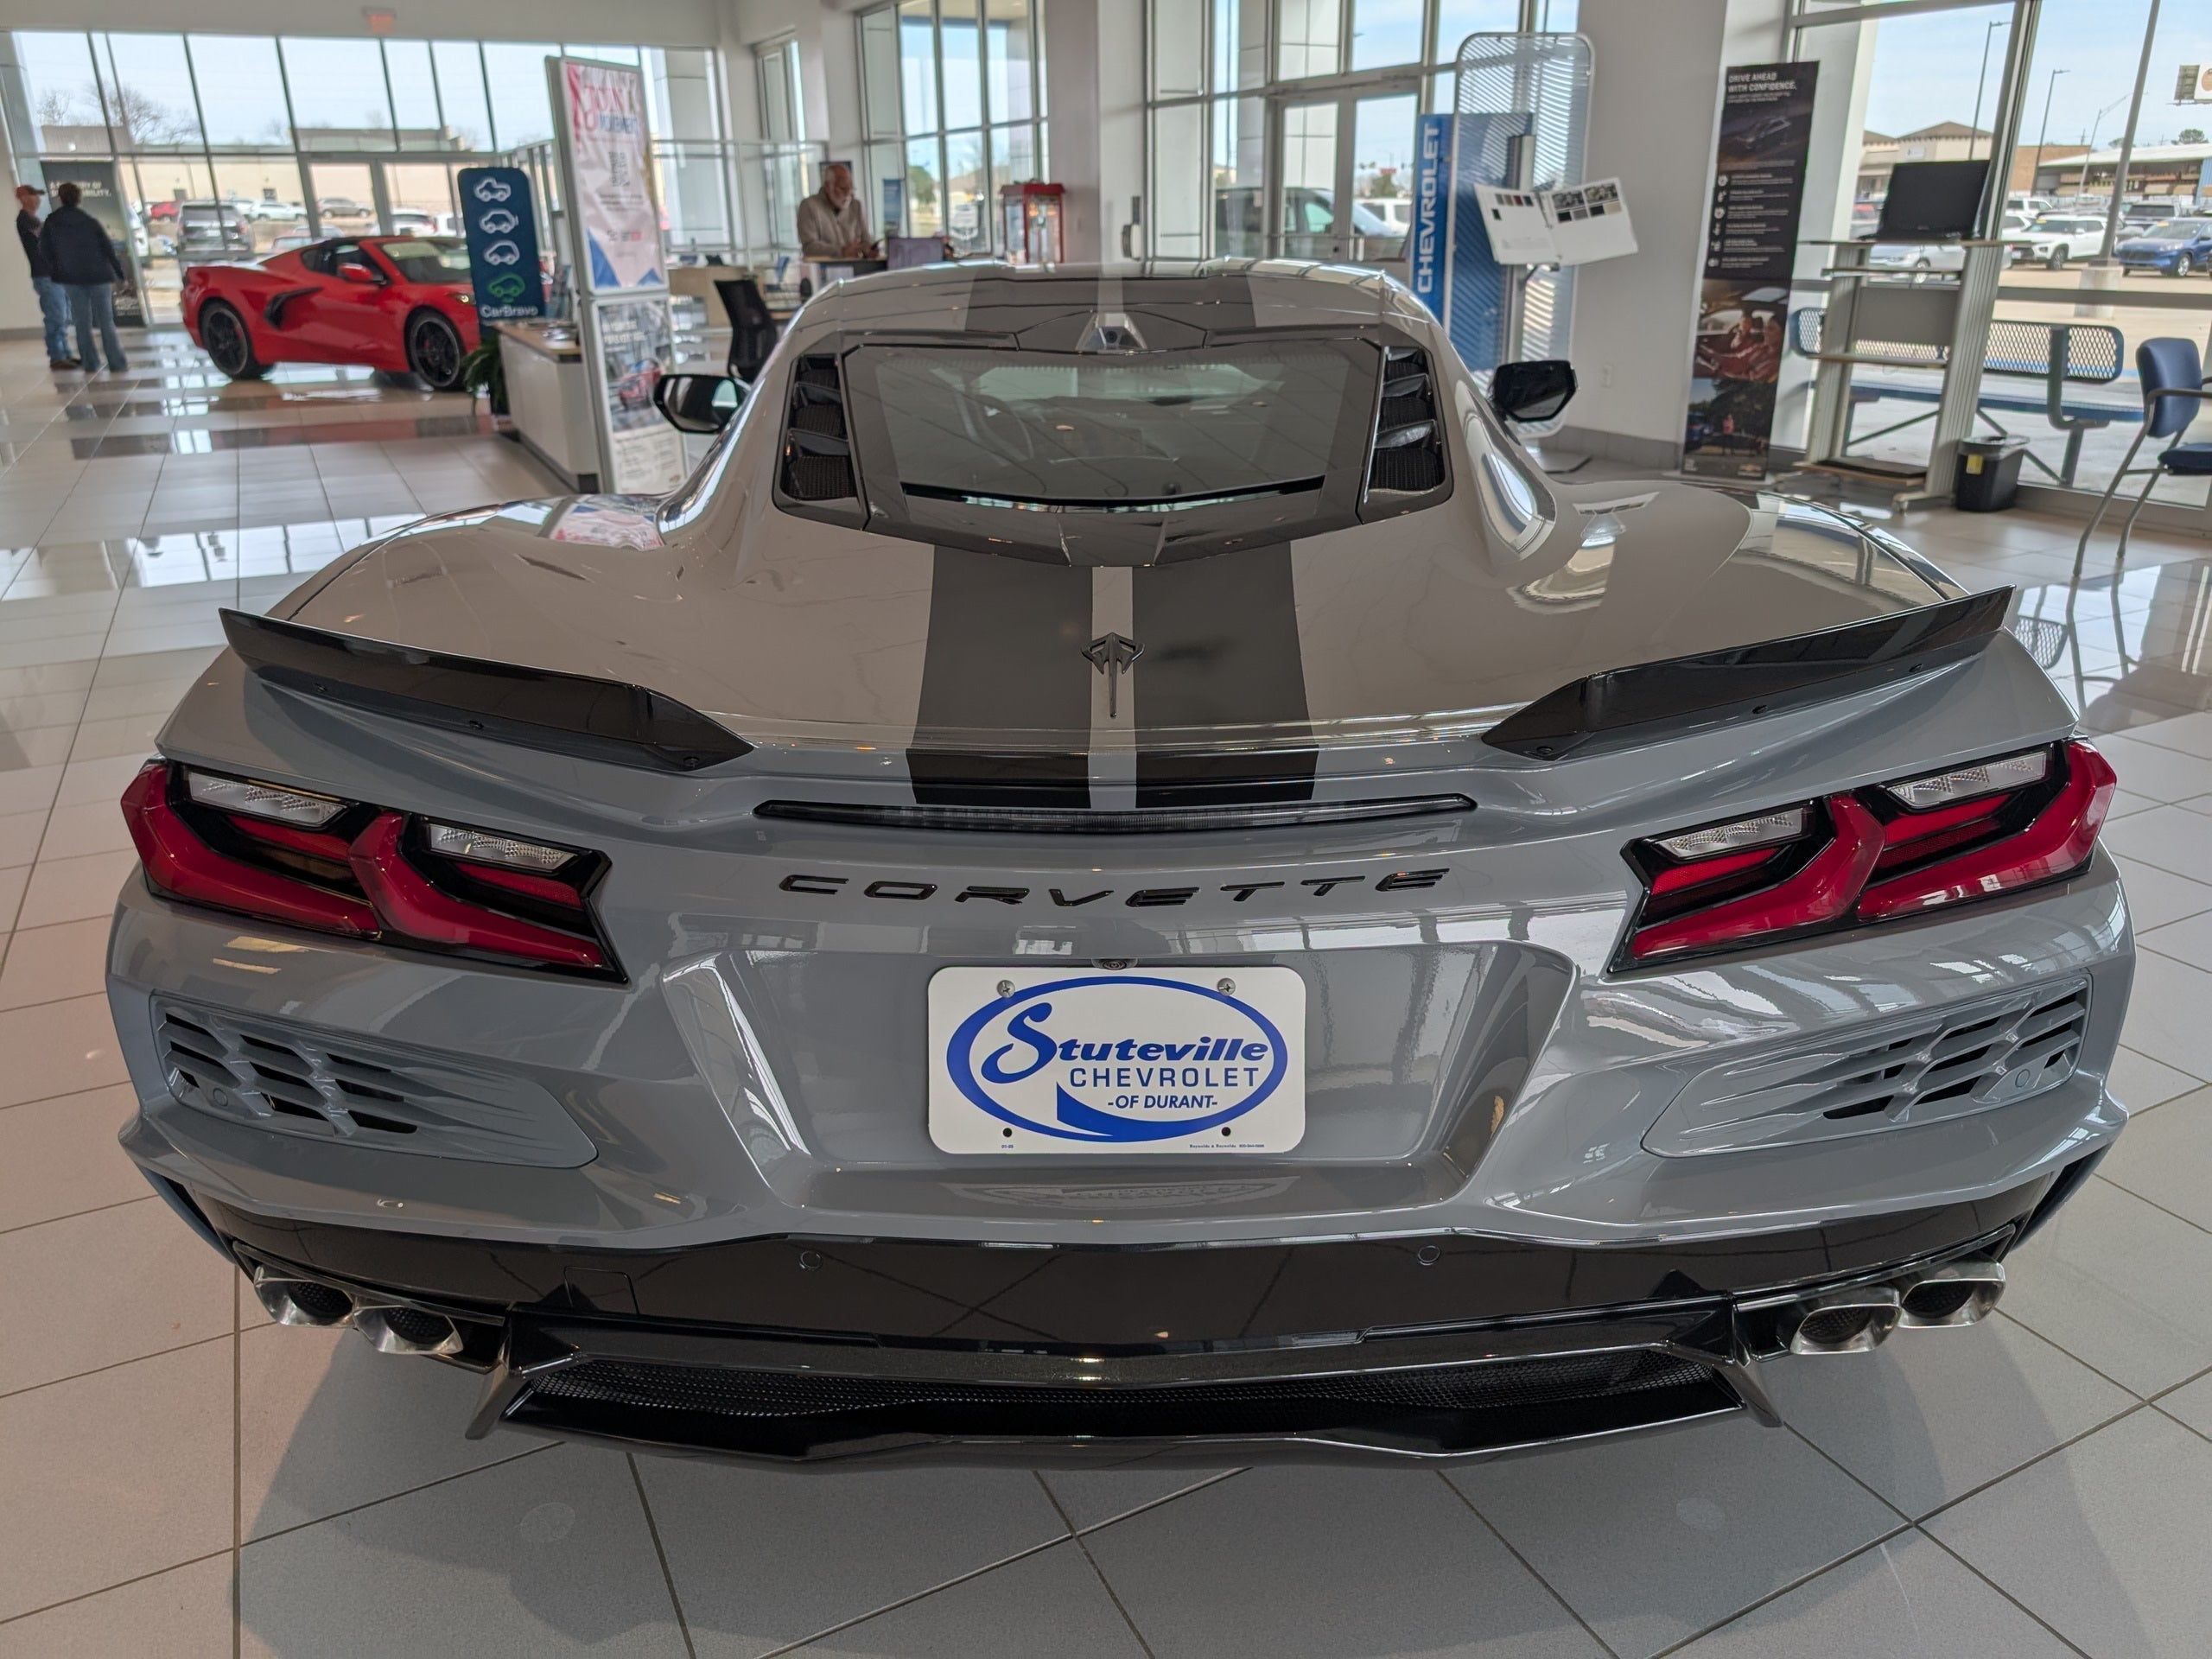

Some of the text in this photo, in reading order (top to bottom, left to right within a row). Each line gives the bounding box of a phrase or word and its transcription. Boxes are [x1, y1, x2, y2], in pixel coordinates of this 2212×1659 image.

[1751, 72, 1777, 81] AHEAD
[1728, 84, 1747, 92] WITH
[1418, 123, 1440, 293] CHEVROLET
[480, 305, 538, 318] CarBravo
[779, 868, 1450, 907] CORVETTE
[981, 1002, 1269, 1084] Stuteville
[1070, 1067, 1260, 1088] CHEVROLET
